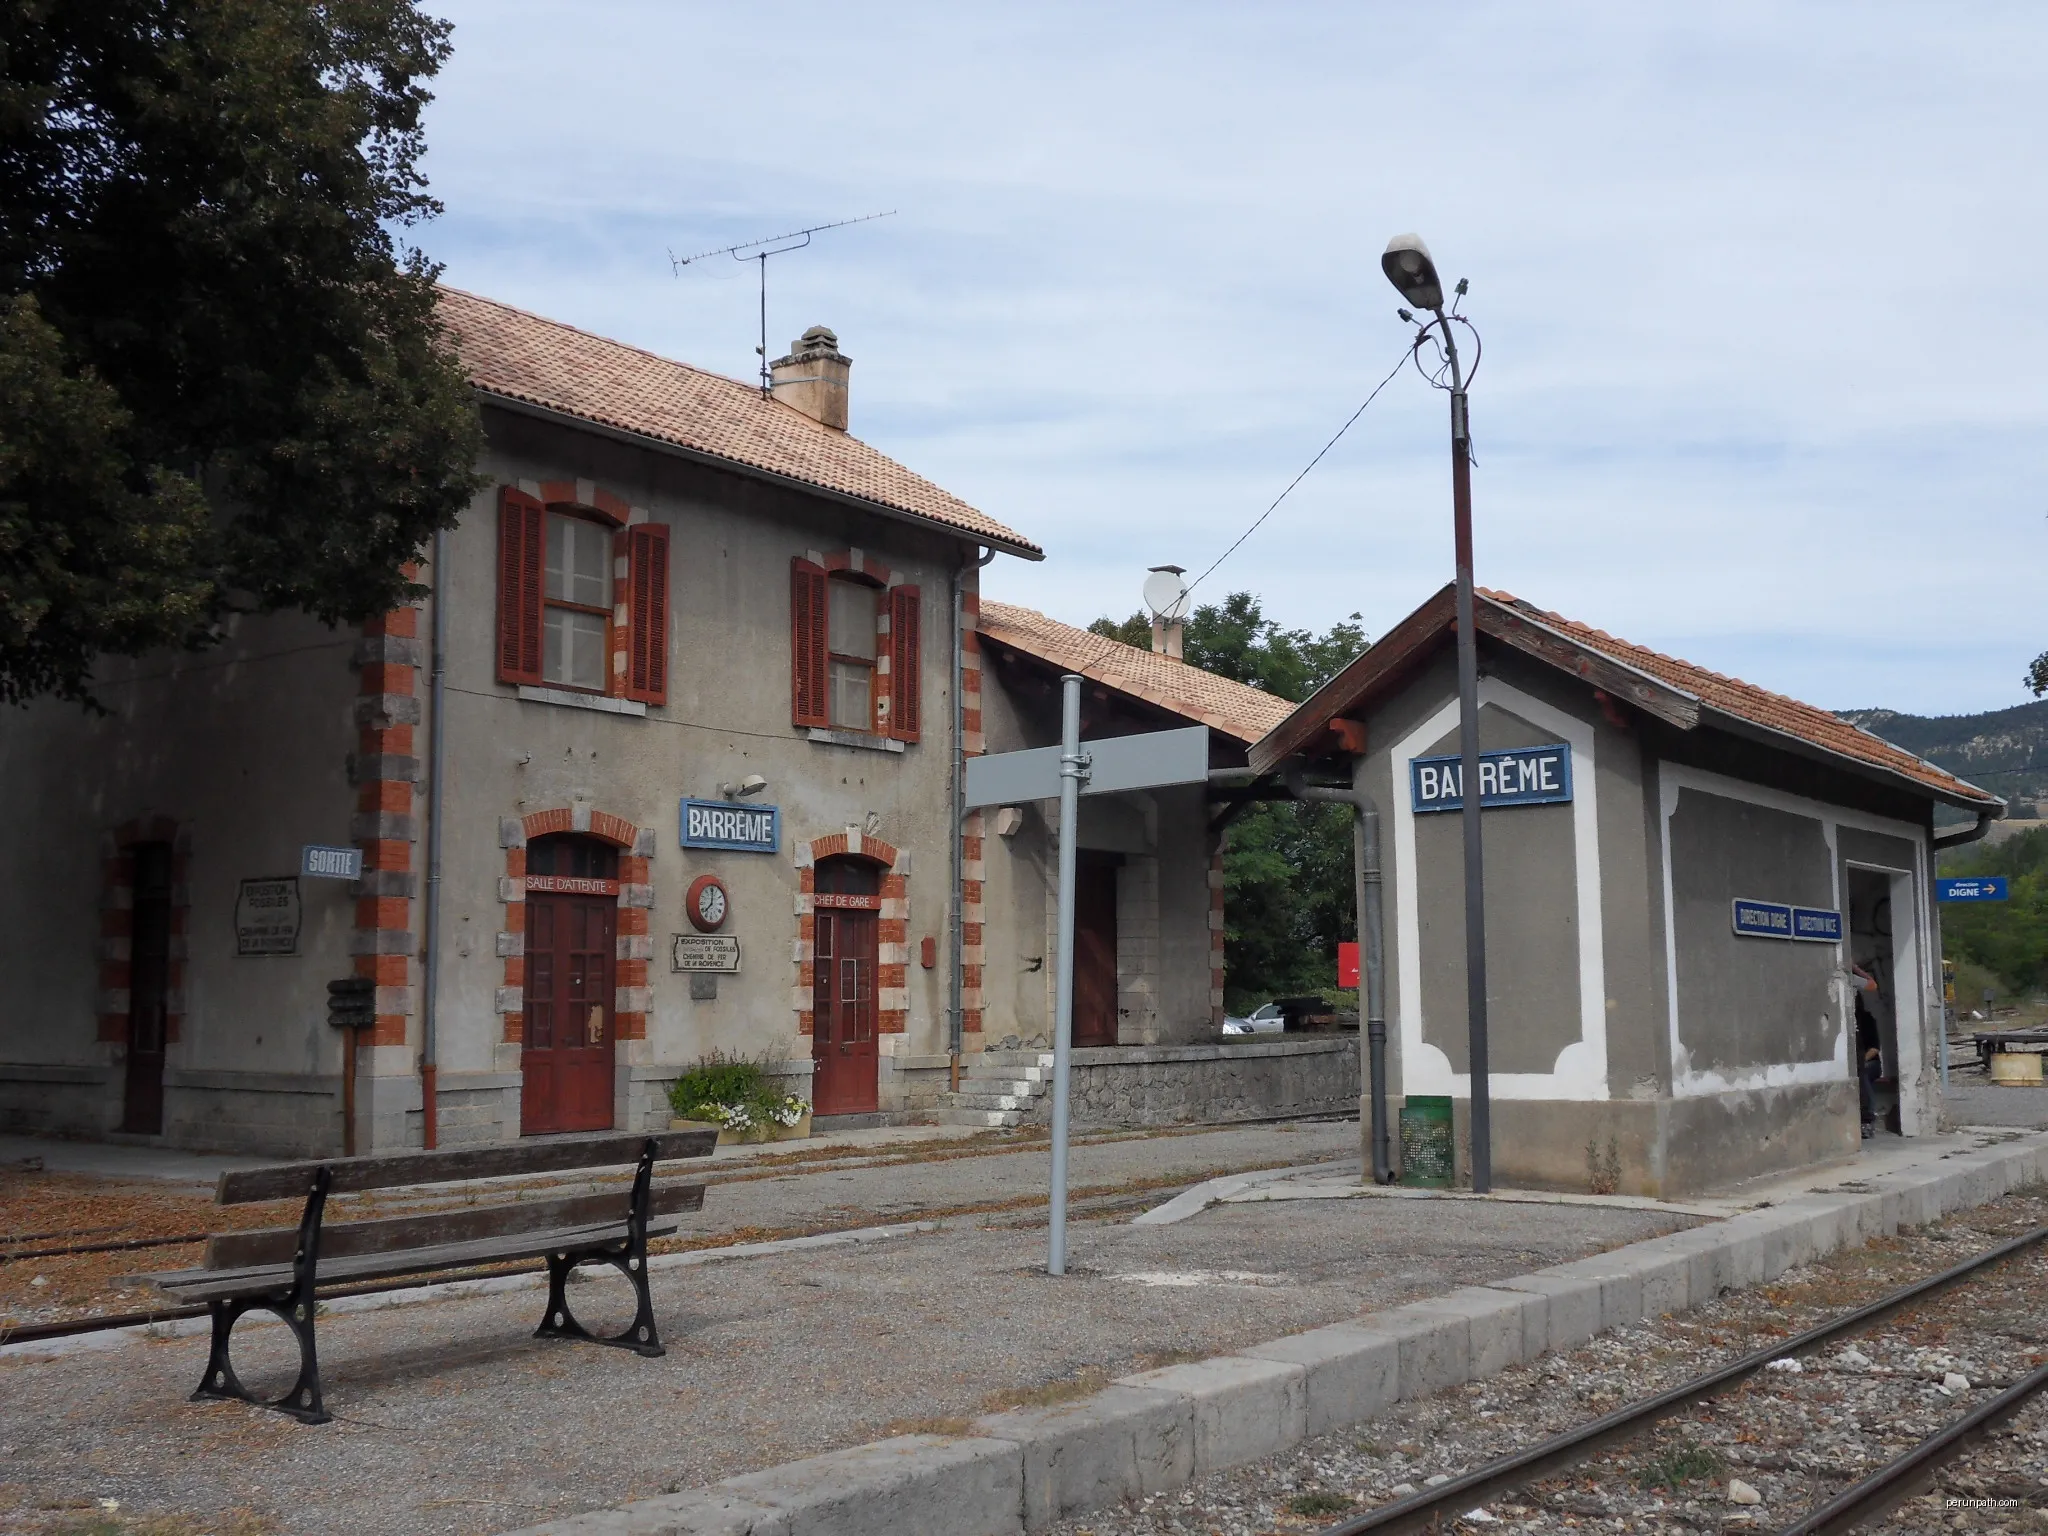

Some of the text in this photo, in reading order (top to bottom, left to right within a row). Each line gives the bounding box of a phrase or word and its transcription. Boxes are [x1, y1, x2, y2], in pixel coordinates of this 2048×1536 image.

[1420, 756, 1560, 800] BARÊME
[689, 809, 772, 842] BARRÊME
[309, 849, 353, 875] SORTIE
[526, 876, 607, 893] SALLE D'ATTENTE
[1948, 888, 1980, 897] DIGNE
[814, 895, 869, 907] CHEF DE GARE
